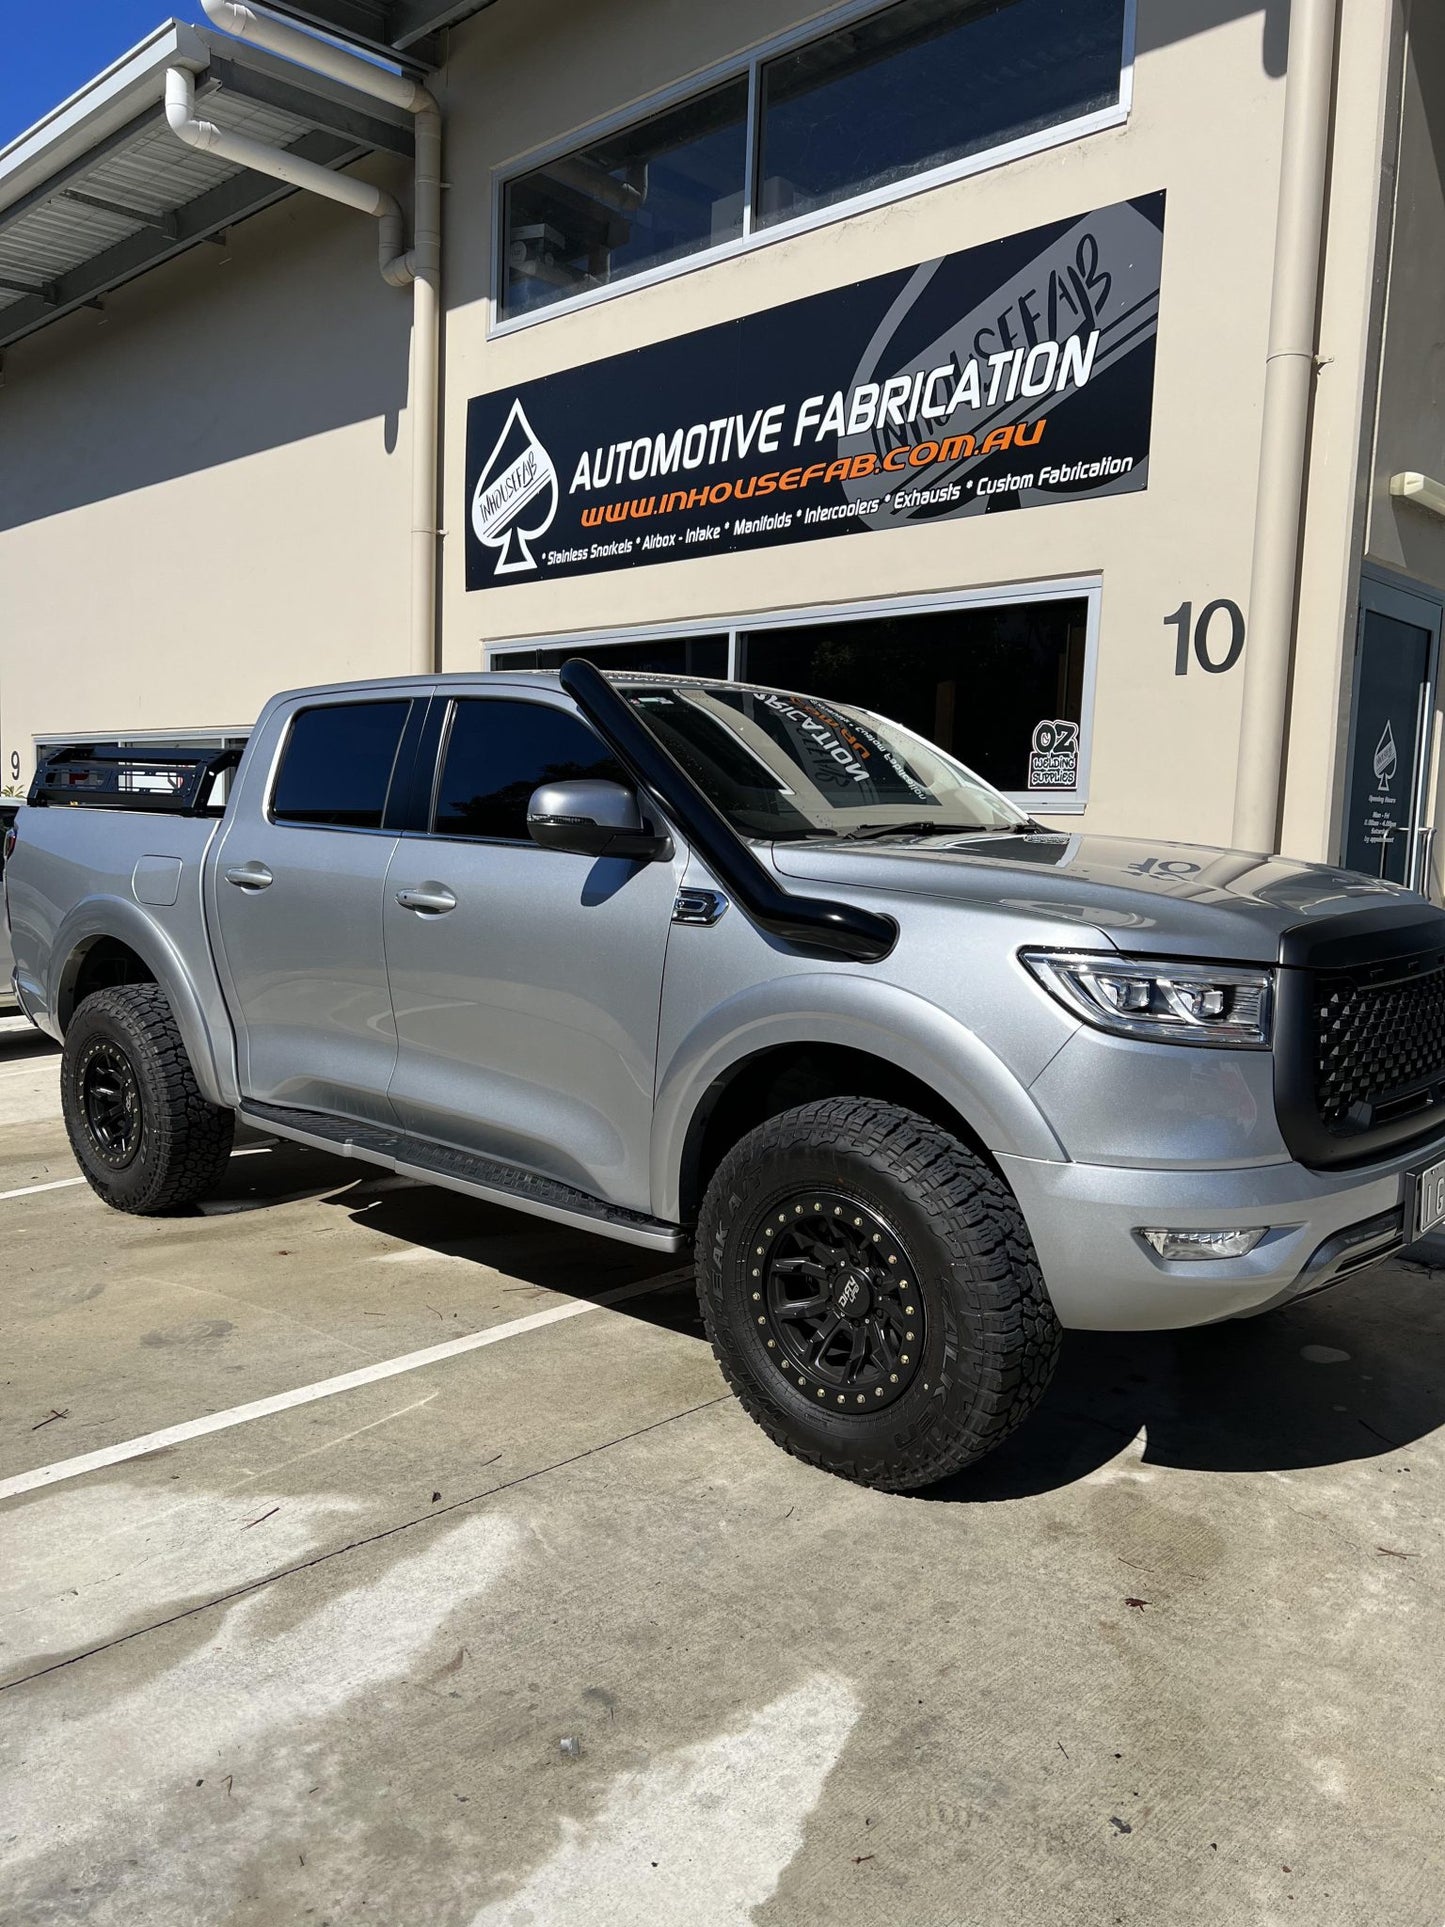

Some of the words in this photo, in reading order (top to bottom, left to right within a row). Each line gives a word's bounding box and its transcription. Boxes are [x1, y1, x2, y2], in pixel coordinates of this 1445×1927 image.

[569, 404, 786, 494] AUTOMOTIVE
[793, 330, 1100, 447] FABRICATION
[547, 547, 589, 566] Stainless
[590, 537, 633, 560] Snorkels
[641, 532, 676, 550] Airbox
[685, 524, 721, 544] Intake
[733, 511, 793, 536] Manifolds
[803, 498, 880, 524] Intercoolers
[893, 482, 962, 509] Exhausts
[976, 472, 1034, 496] Custom
[1038, 456, 1133, 486] Fabrication
[1163, 598, 1246, 676] 10
[10, 750, 20, 781] 9
[1033, 720, 1078, 754] OZ
